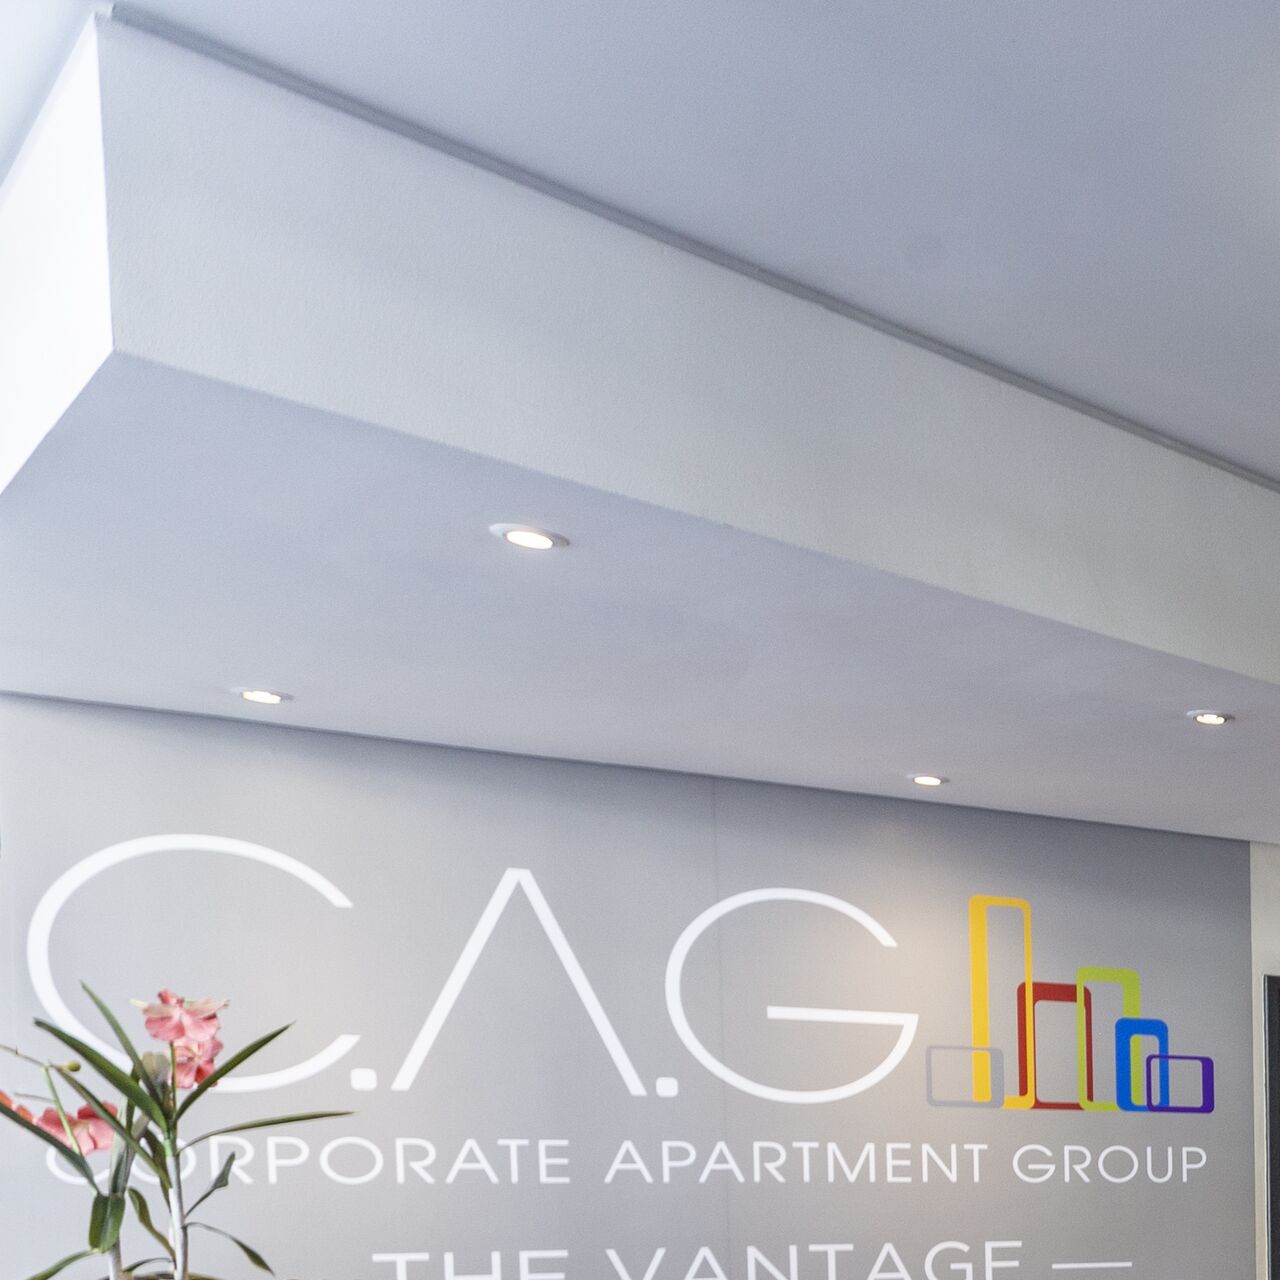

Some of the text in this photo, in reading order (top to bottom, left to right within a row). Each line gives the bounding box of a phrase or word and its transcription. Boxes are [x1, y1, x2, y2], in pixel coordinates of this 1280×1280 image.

[46, 1133, 1209, 1188] CORPORATE APARTMENT GROUP
